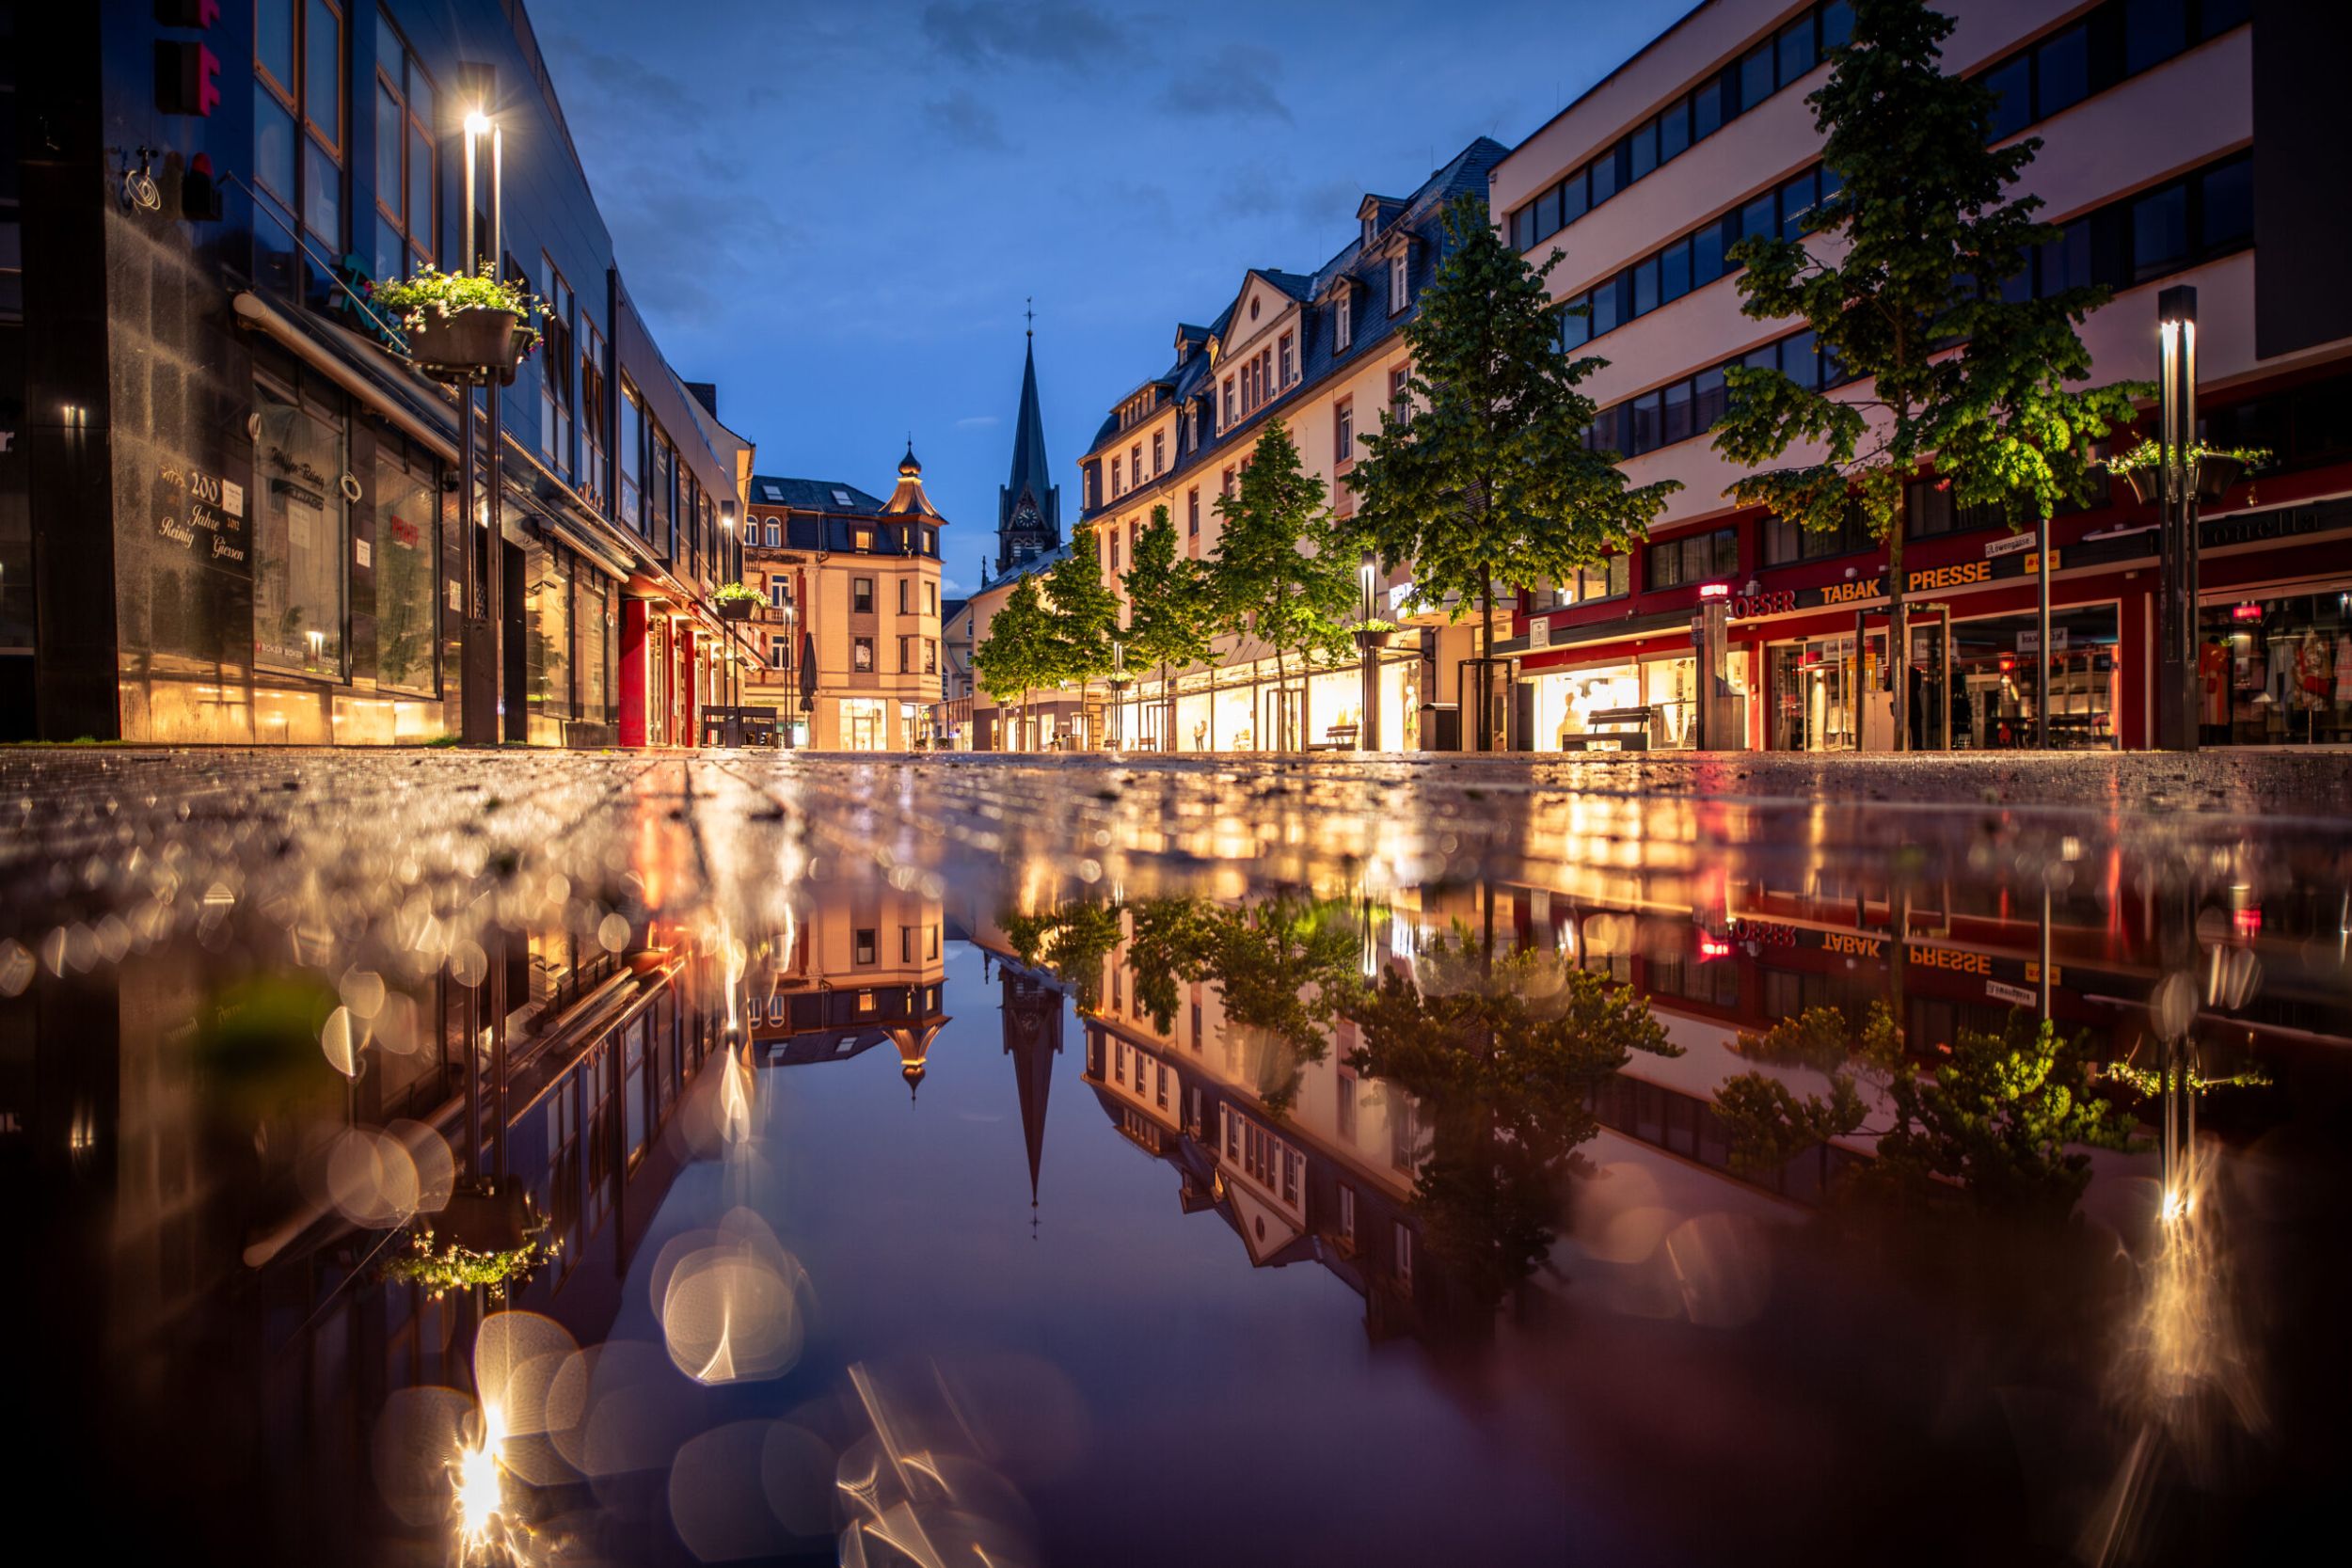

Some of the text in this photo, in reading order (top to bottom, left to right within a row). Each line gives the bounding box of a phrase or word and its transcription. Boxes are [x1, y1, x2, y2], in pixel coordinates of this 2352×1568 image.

[191, 471, 218, 502] 200
[187, 504, 220, 531] Jahre
[2199, 509, 2321, 546] ronella
[158, 516, 244, 562] Reinig Giessen
[1732, 590, 1796, 619] OESER
[1820, 578, 1881, 605] TABAK
[1909, 561, 1992, 592] PRESSE
